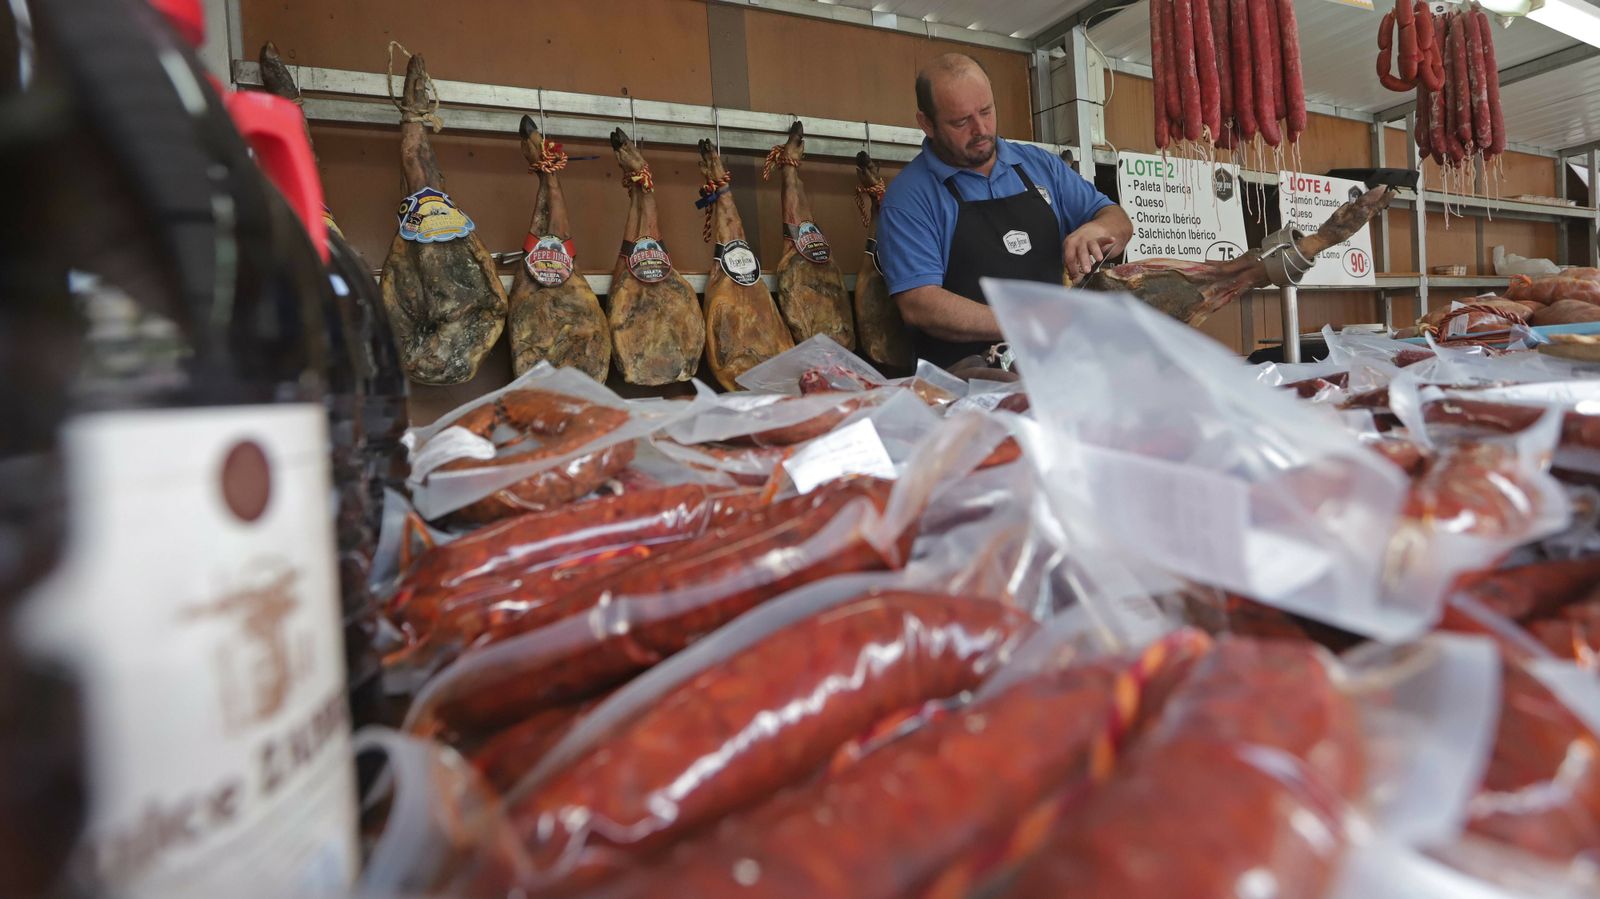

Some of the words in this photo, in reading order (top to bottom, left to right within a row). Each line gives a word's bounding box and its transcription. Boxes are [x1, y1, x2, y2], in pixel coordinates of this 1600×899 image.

[1126, 159, 1163, 177] LOTE
[1167, 163, 1174, 178] 2
[1133, 180, 1161, 192] Paleta
[1164, 182, 1191, 194] berica
[1290, 177, 1320, 193] LOTE
[1324, 181, 1331, 194] 4
[1135, 196, 1164, 207] Queso
[1290, 195, 1313, 205] Jamón
[1314, 196, 1340, 207] Cruzado
[1137, 212, 1170, 223] Chorizo
[1173, 213, 1201, 225] Ibérico
[1291, 208, 1312, 218] Queso
[1139, 228, 1186, 239] Salchichón
[1189, 229, 1216, 240] Ibérico
[533, 250, 550, 260] PEPE
[1140, 244, 1163, 255] Caña
[1165, 245, 1175, 255] de
[1178, 245, 1201, 255] Lomo
